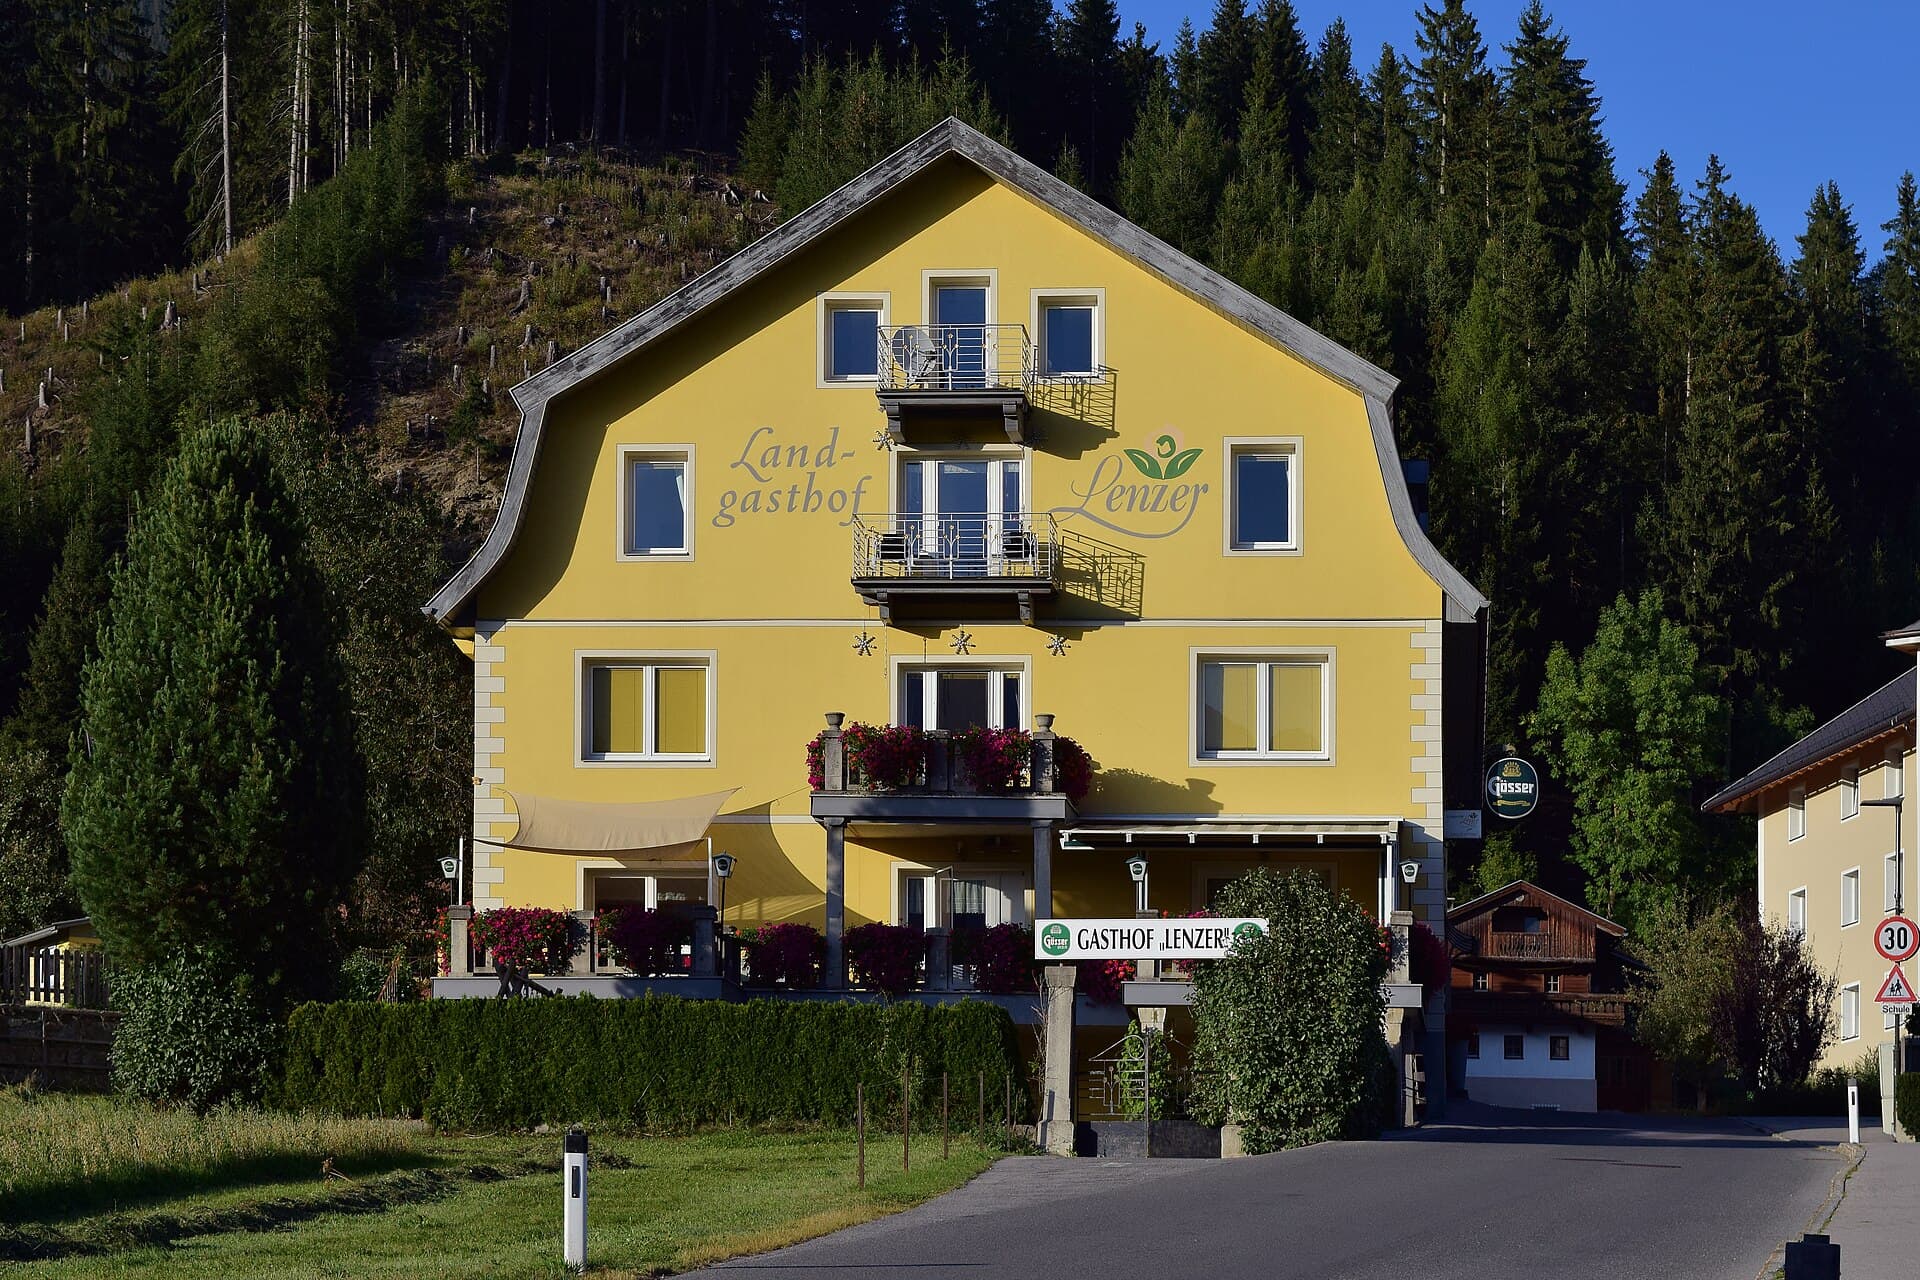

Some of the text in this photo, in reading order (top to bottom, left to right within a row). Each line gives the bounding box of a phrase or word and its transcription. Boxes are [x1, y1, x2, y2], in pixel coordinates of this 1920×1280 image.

[730, 426, 855, 482] Land-
[711, 471, 872, 528] gasthof
[1049, 454, 1209, 538] Lenzer
[1488, 776, 1534, 798] Gösser
[1077, 928, 1154, 950] GASTHOF
[1884, 927, 1908, 950] 30
[1882, 1005, 1910, 1013] Schule
